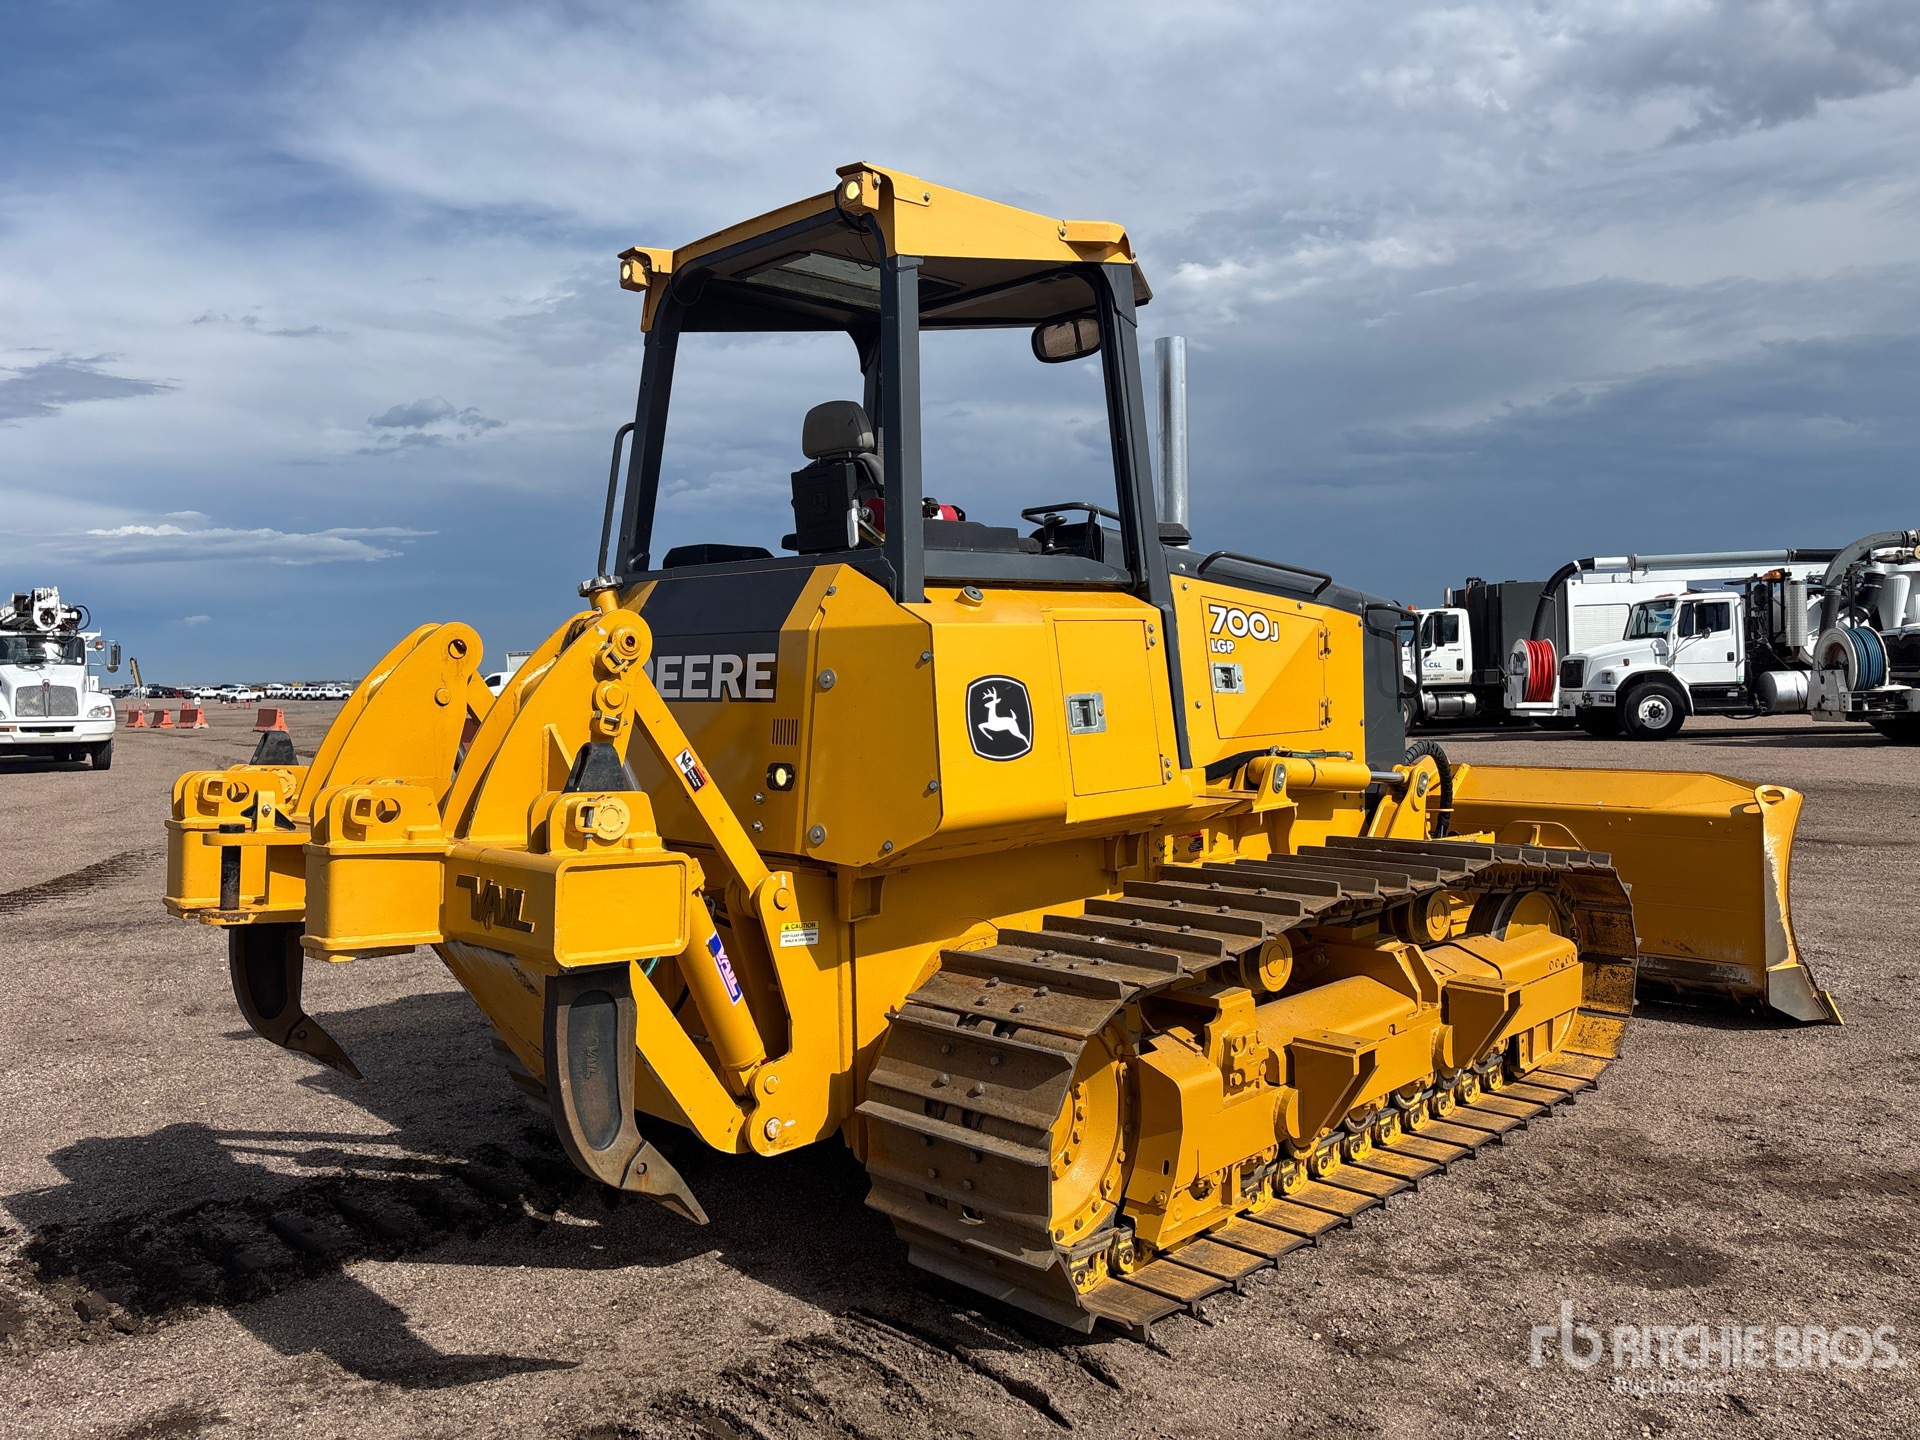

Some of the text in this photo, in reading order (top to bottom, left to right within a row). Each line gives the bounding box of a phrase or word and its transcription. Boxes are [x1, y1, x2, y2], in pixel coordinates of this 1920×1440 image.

[1208, 603, 1280, 642] 700J
[1210, 637, 1235, 654] LGP
[644, 653, 776, 698] EERE
[715, 944, 739, 998] VAIL
